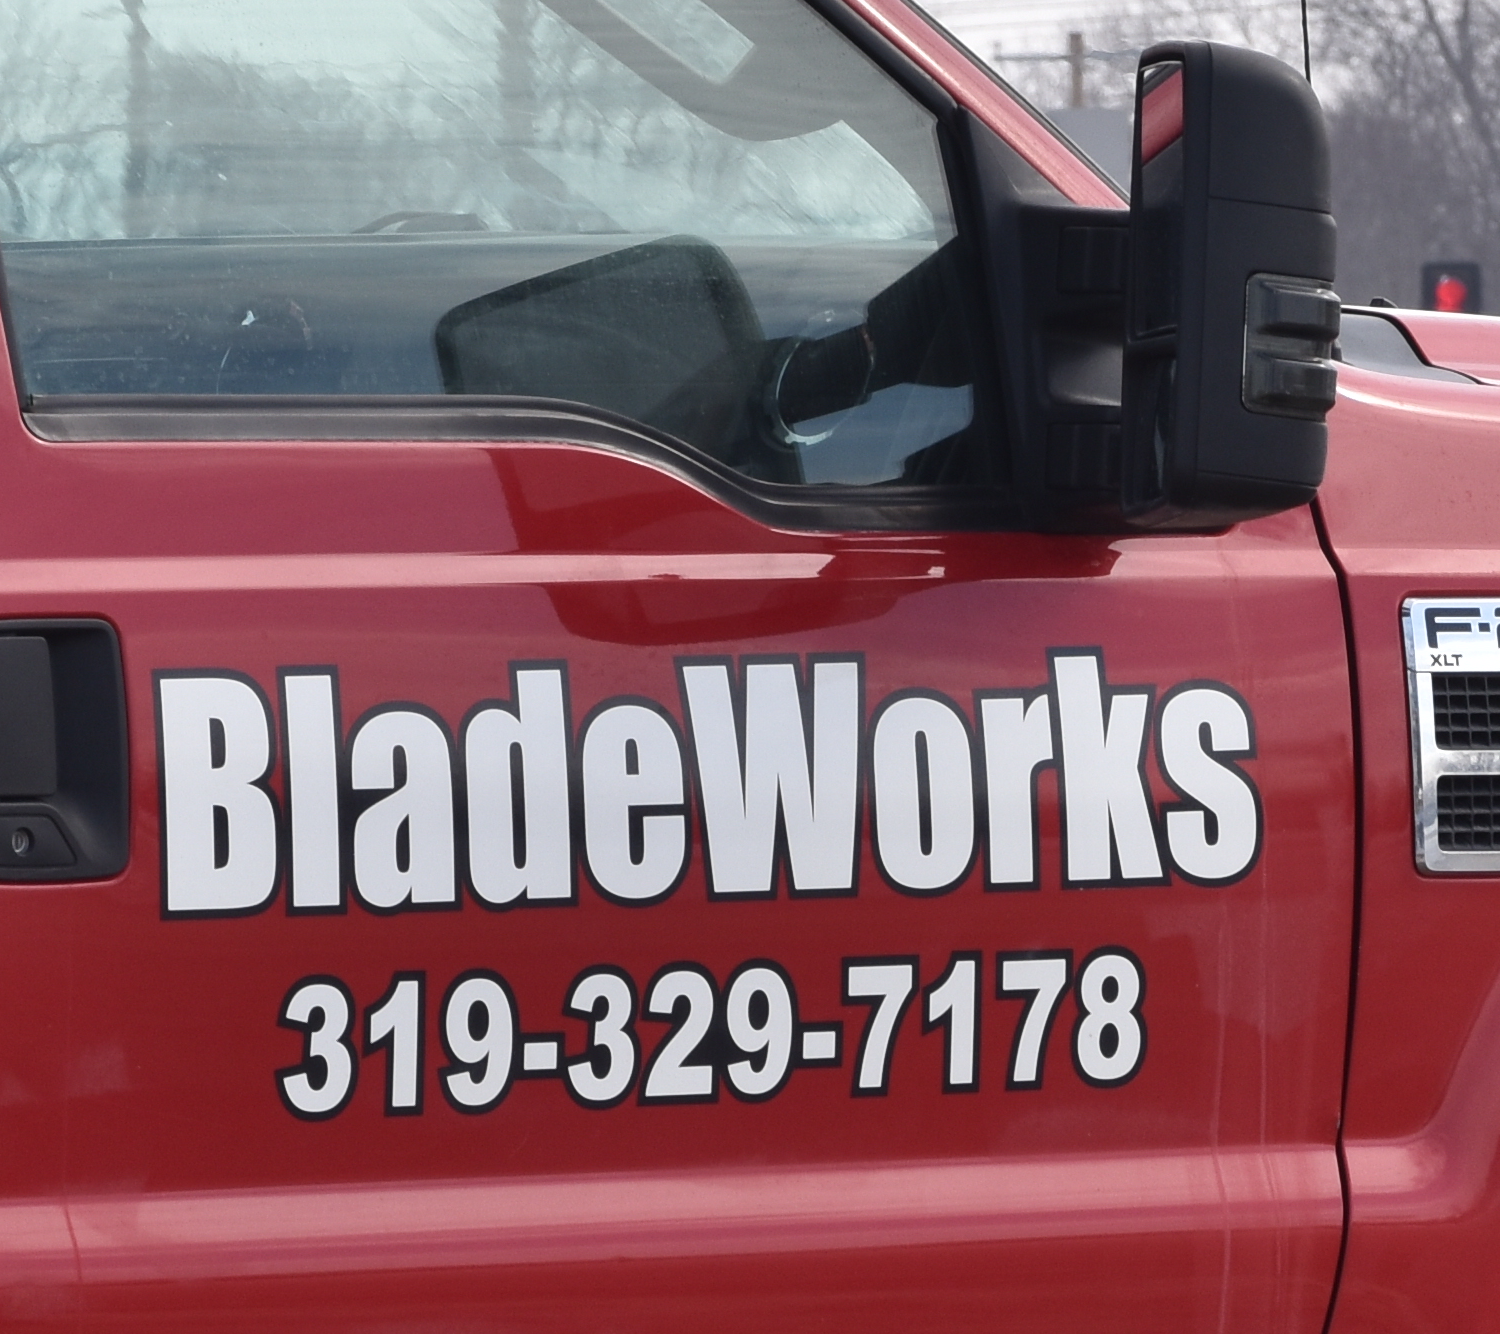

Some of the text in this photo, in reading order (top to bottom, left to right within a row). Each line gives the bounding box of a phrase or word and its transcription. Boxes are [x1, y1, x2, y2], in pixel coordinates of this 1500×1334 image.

[1430, 654, 1463, 667] XLT
[156, 652, 1262, 914] BladeWorks
[279, 954, 1145, 1114] 319-329-7178
